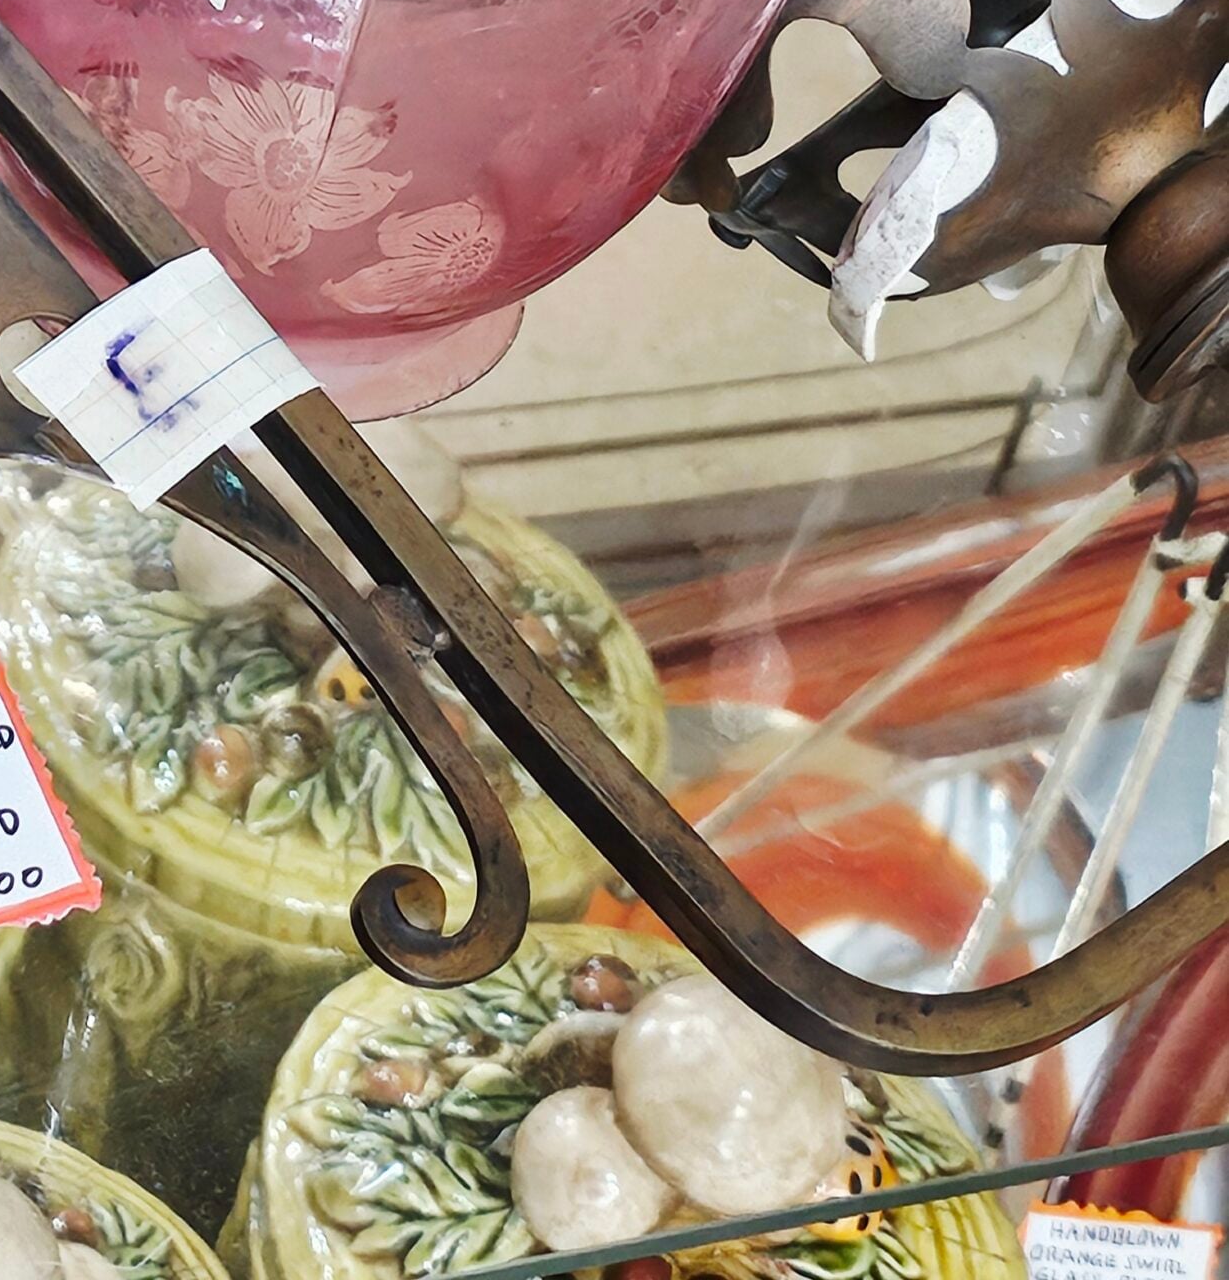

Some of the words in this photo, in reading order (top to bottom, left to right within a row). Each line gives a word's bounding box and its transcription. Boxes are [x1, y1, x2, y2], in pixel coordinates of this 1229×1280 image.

[1049, 1221, 1181, 1249] HANDBLOWN
[1029, 1244, 1116, 1269] ORANGE
[1124, 1250, 1187, 1275] SWIRL
